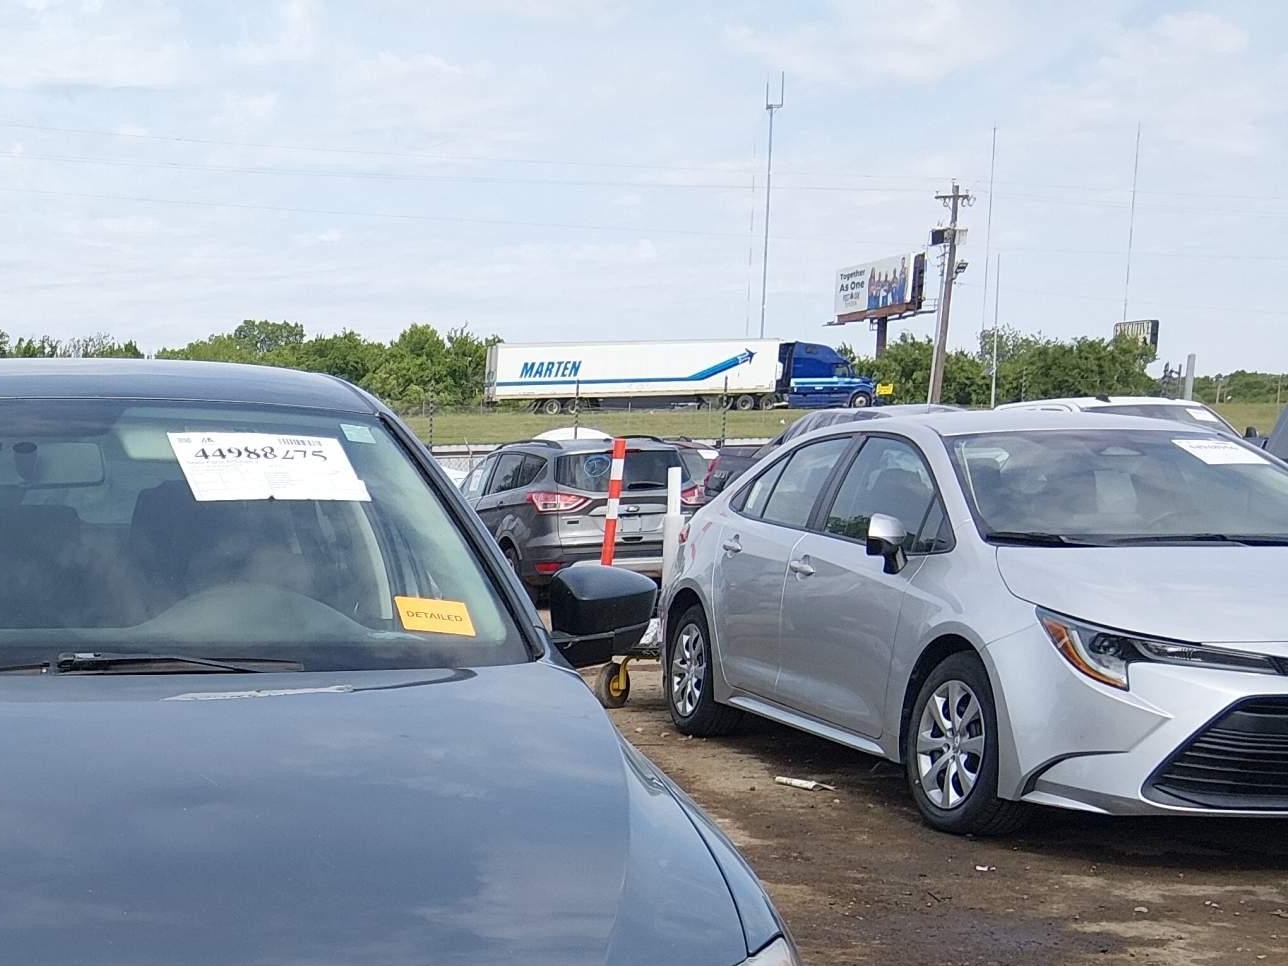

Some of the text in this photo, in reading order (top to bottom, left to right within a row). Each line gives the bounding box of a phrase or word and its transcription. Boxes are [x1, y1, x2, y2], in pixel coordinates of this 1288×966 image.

[850, 281, 865, 290] One
[520, 360, 582, 378] MARTEN
[406, 611, 463, 622] DETAILED
